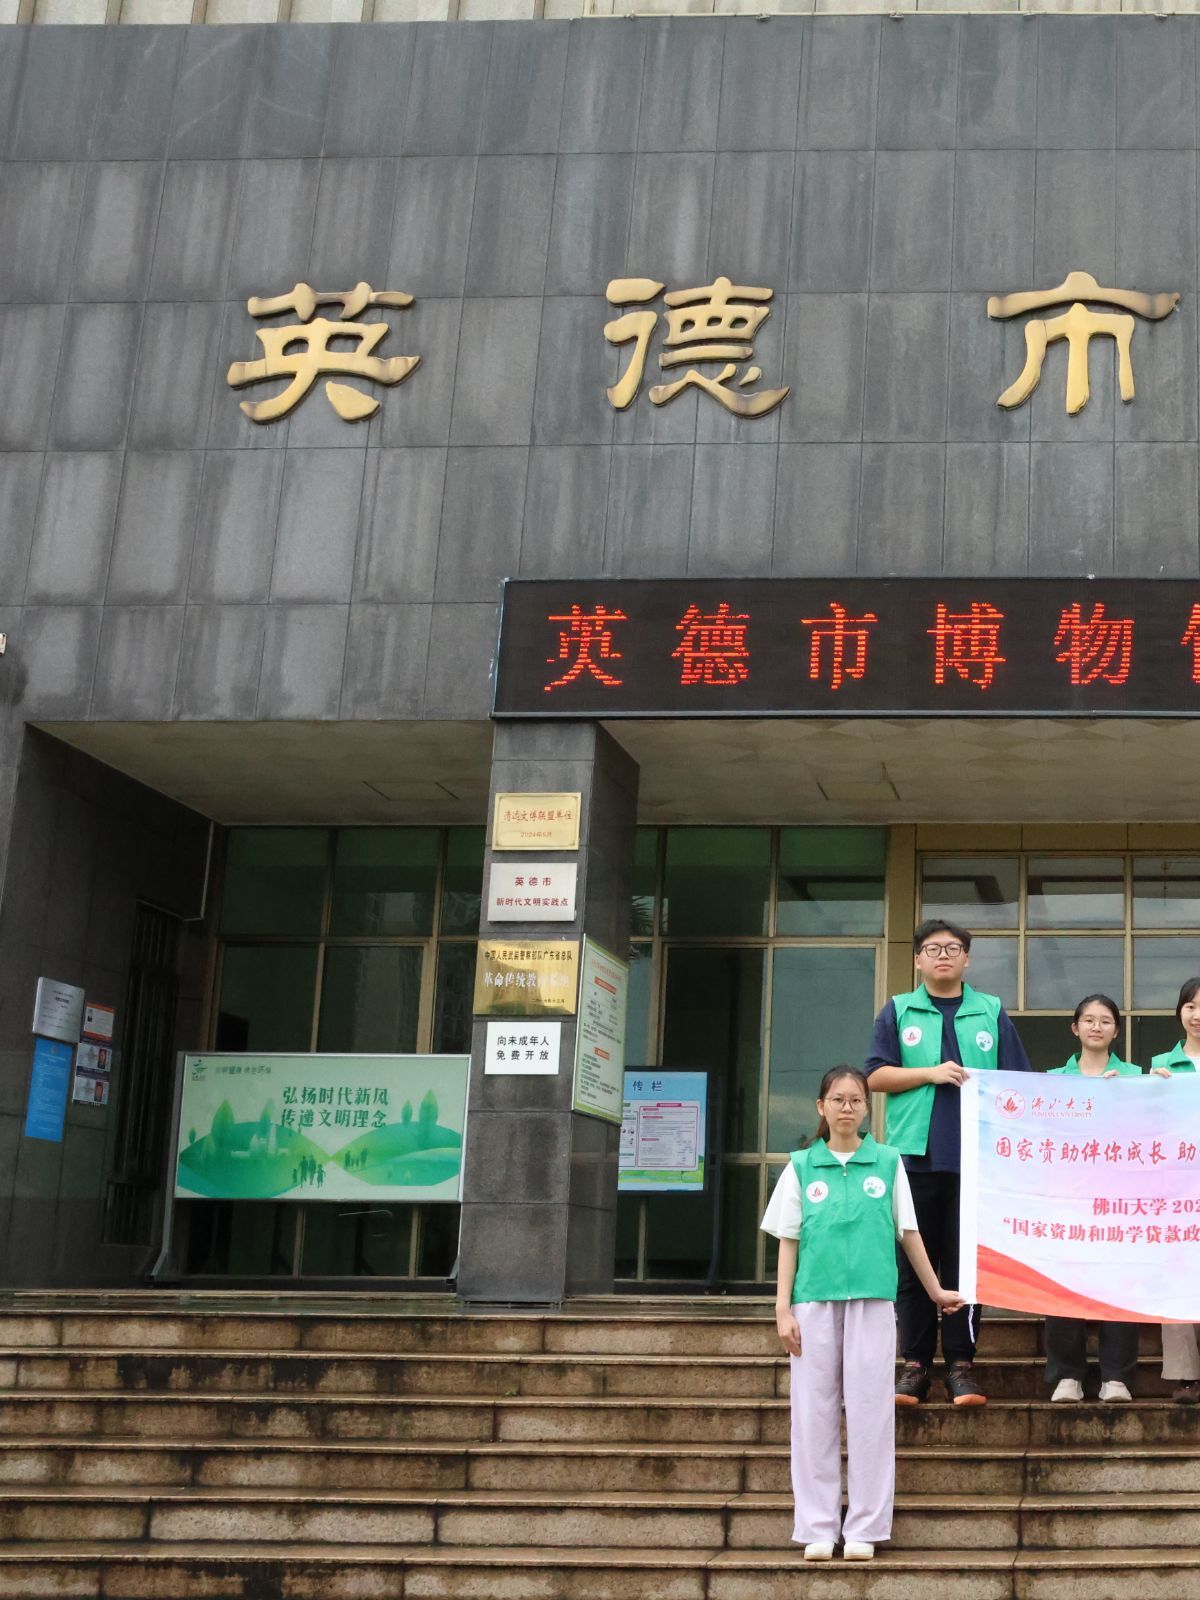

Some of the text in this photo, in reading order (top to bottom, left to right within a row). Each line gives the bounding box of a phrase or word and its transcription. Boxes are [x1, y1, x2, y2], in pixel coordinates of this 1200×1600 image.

[514, 877, 552, 887] 英德市
[496, 898, 569, 907] 新时代文明实践点
[497, 1035, 550, 1047] 向未成年人
[496, 1050, 549, 1061] 免费开放
[283, 1086, 389, 1107] 弘扬时代新风
[280, 1108, 388, 1128] 传递文明理念
[995, 1136, 1168, 1166] 国家资助伴你成长
